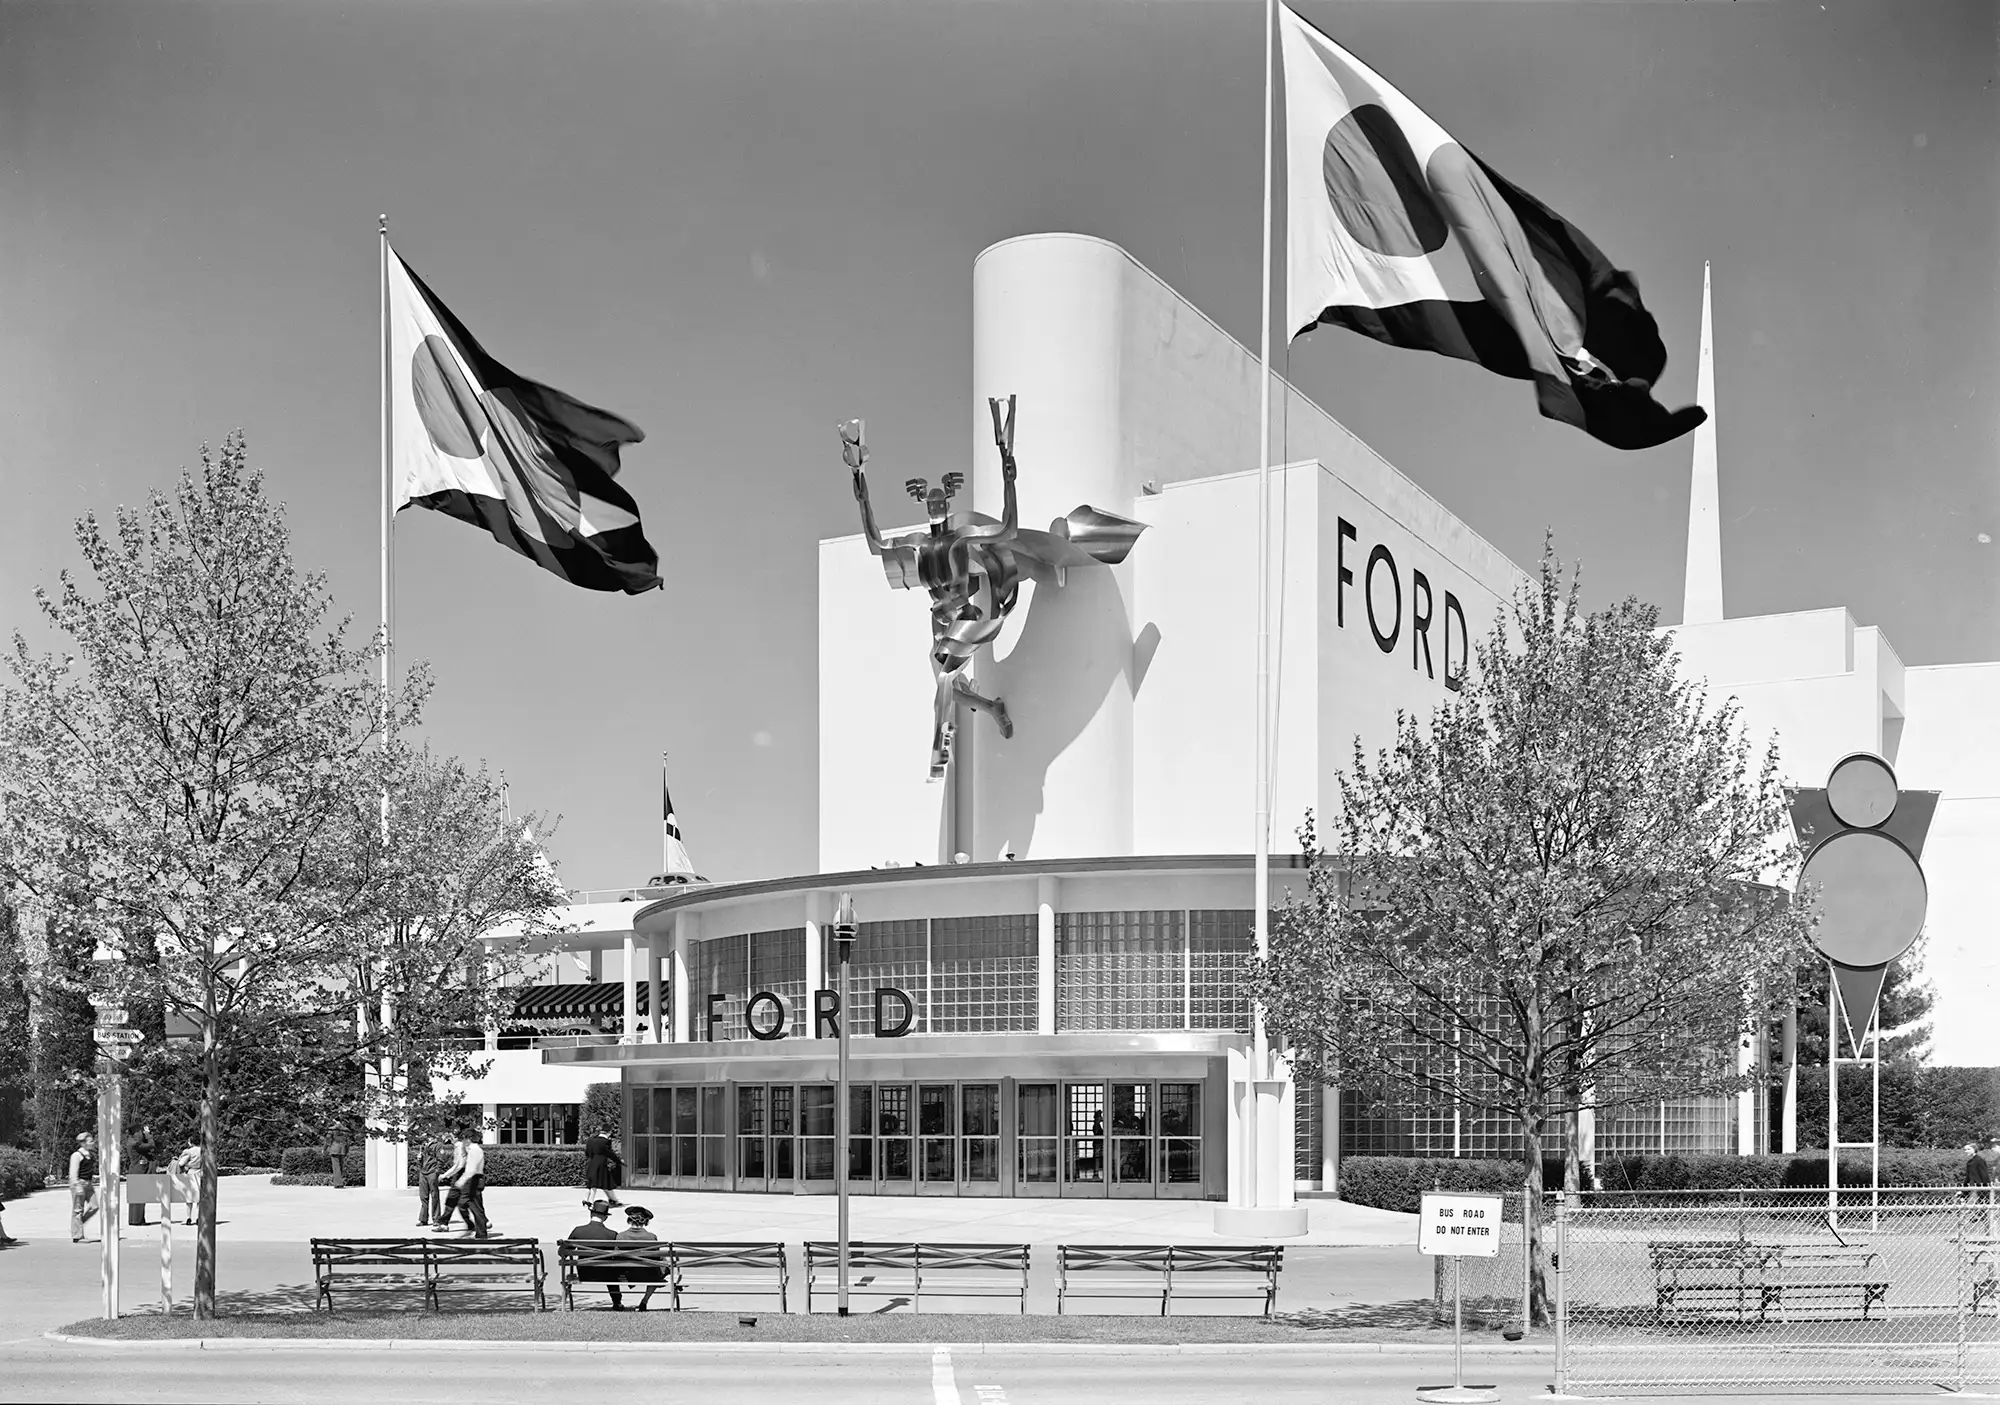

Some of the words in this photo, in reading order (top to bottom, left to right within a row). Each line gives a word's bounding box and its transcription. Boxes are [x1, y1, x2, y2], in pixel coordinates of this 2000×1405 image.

[1338, 516, 1468, 692] FORD
[708, 987, 914, 1042] FORD
[97, 1031, 111, 1039] BUS
[112, 1032, 140, 1040] STATION
[1439, 1208, 1454, 1217] BUS
[1463, 1209, 1485, 1219] ROAD
[1436, 1225, 1446, 1235] DO
[1450, 1226, 1465, 1235] NOT
[1467, 1226, 1490, 1236] ENTER
